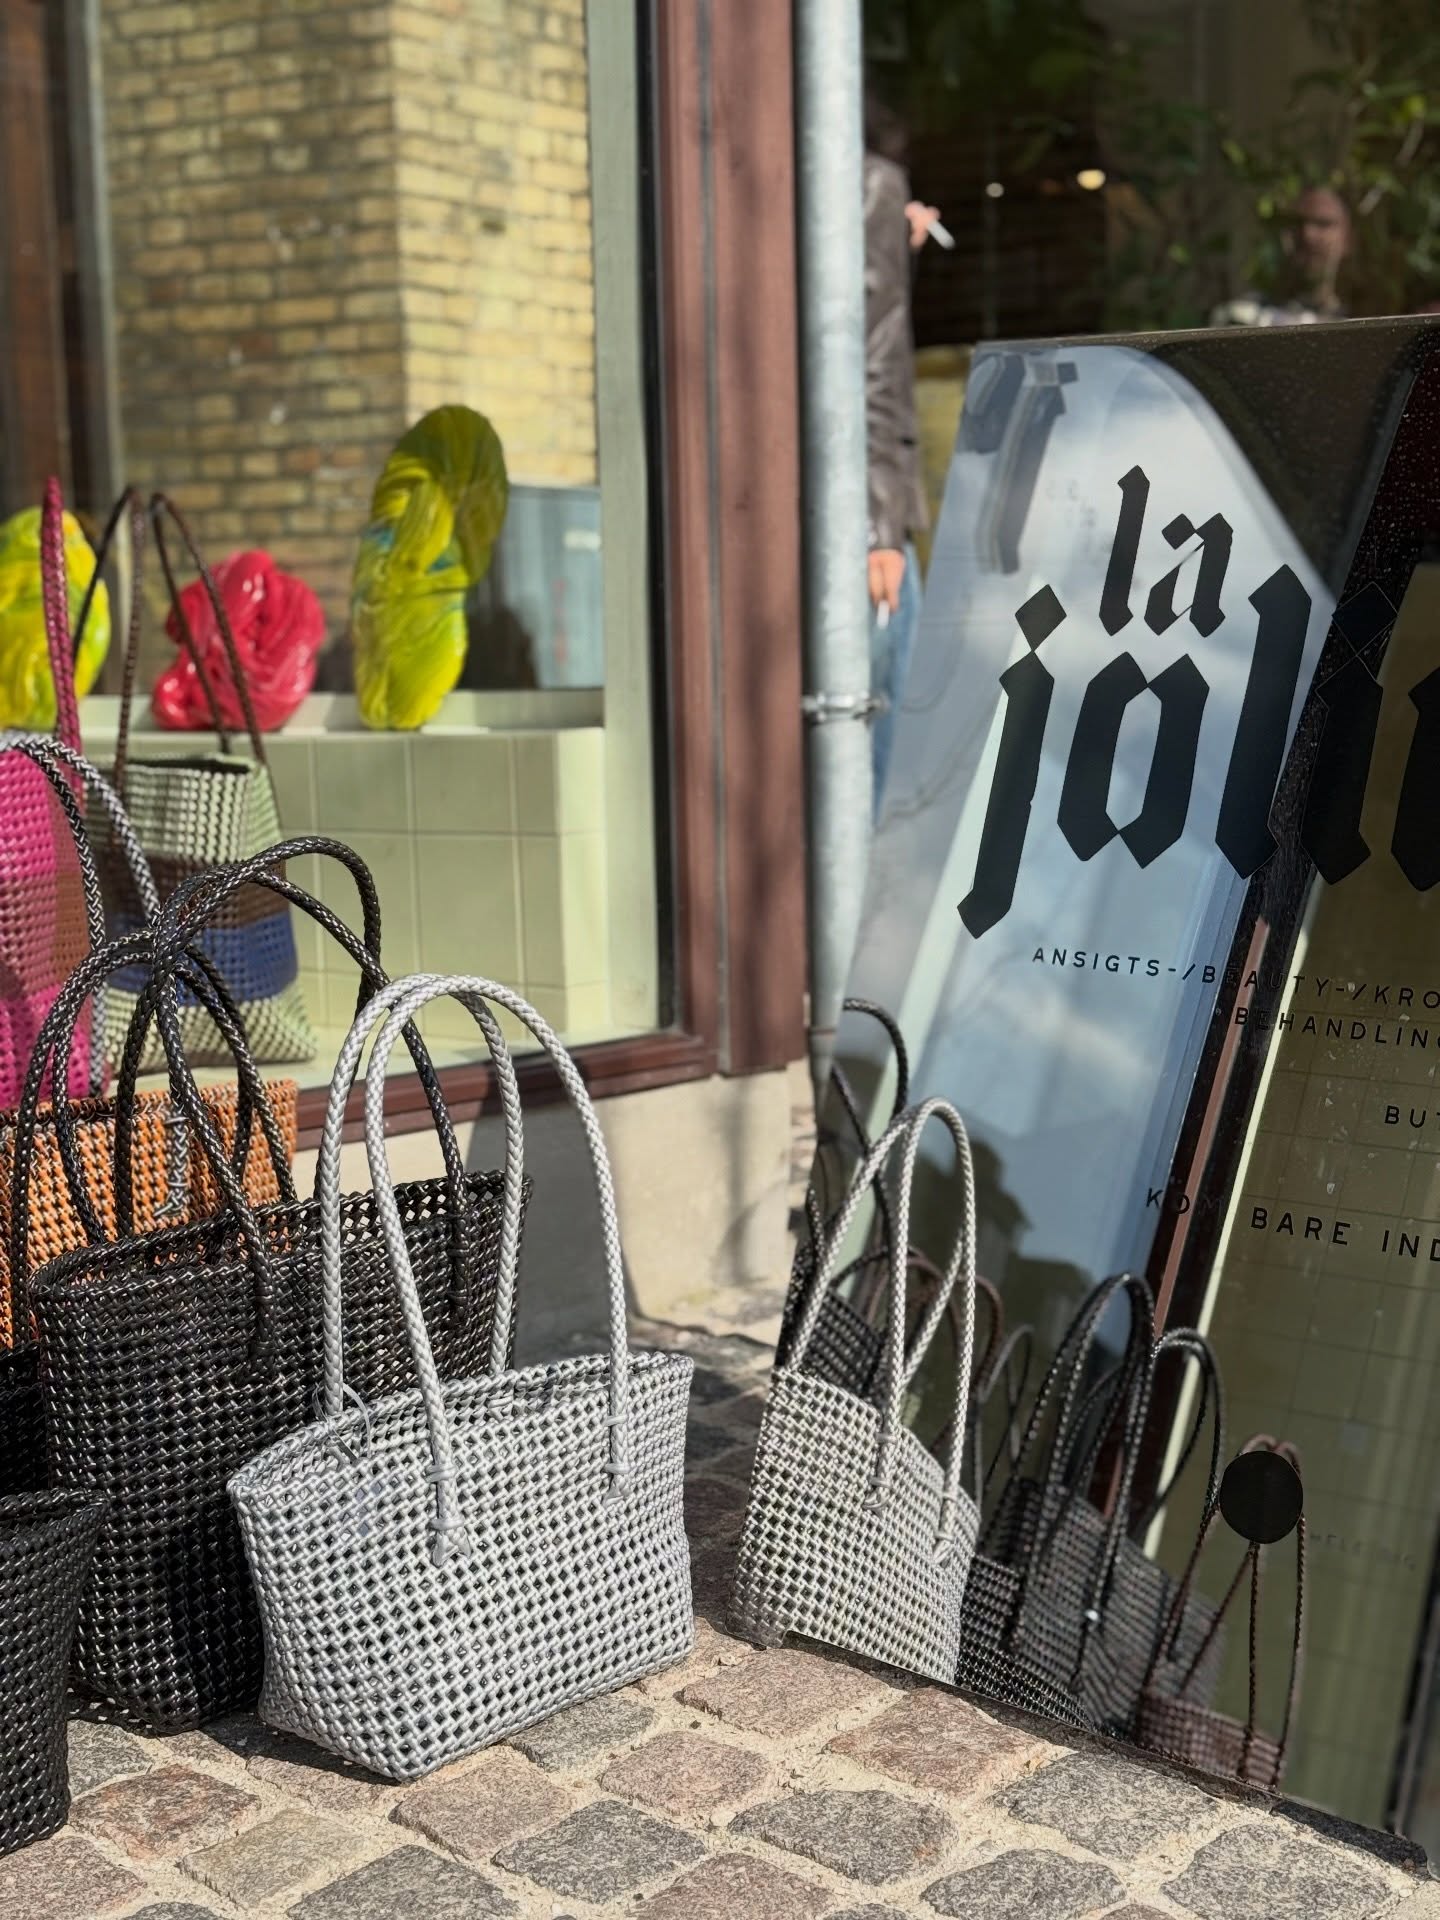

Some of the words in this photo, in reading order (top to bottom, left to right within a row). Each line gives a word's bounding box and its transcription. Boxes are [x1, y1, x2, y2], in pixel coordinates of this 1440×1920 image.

[1099, 465, 1234, 638] la
[1234, 1007, 1440, 1049] BEHANDLIN
[1251, 1206, 1351, 1247] BARE
